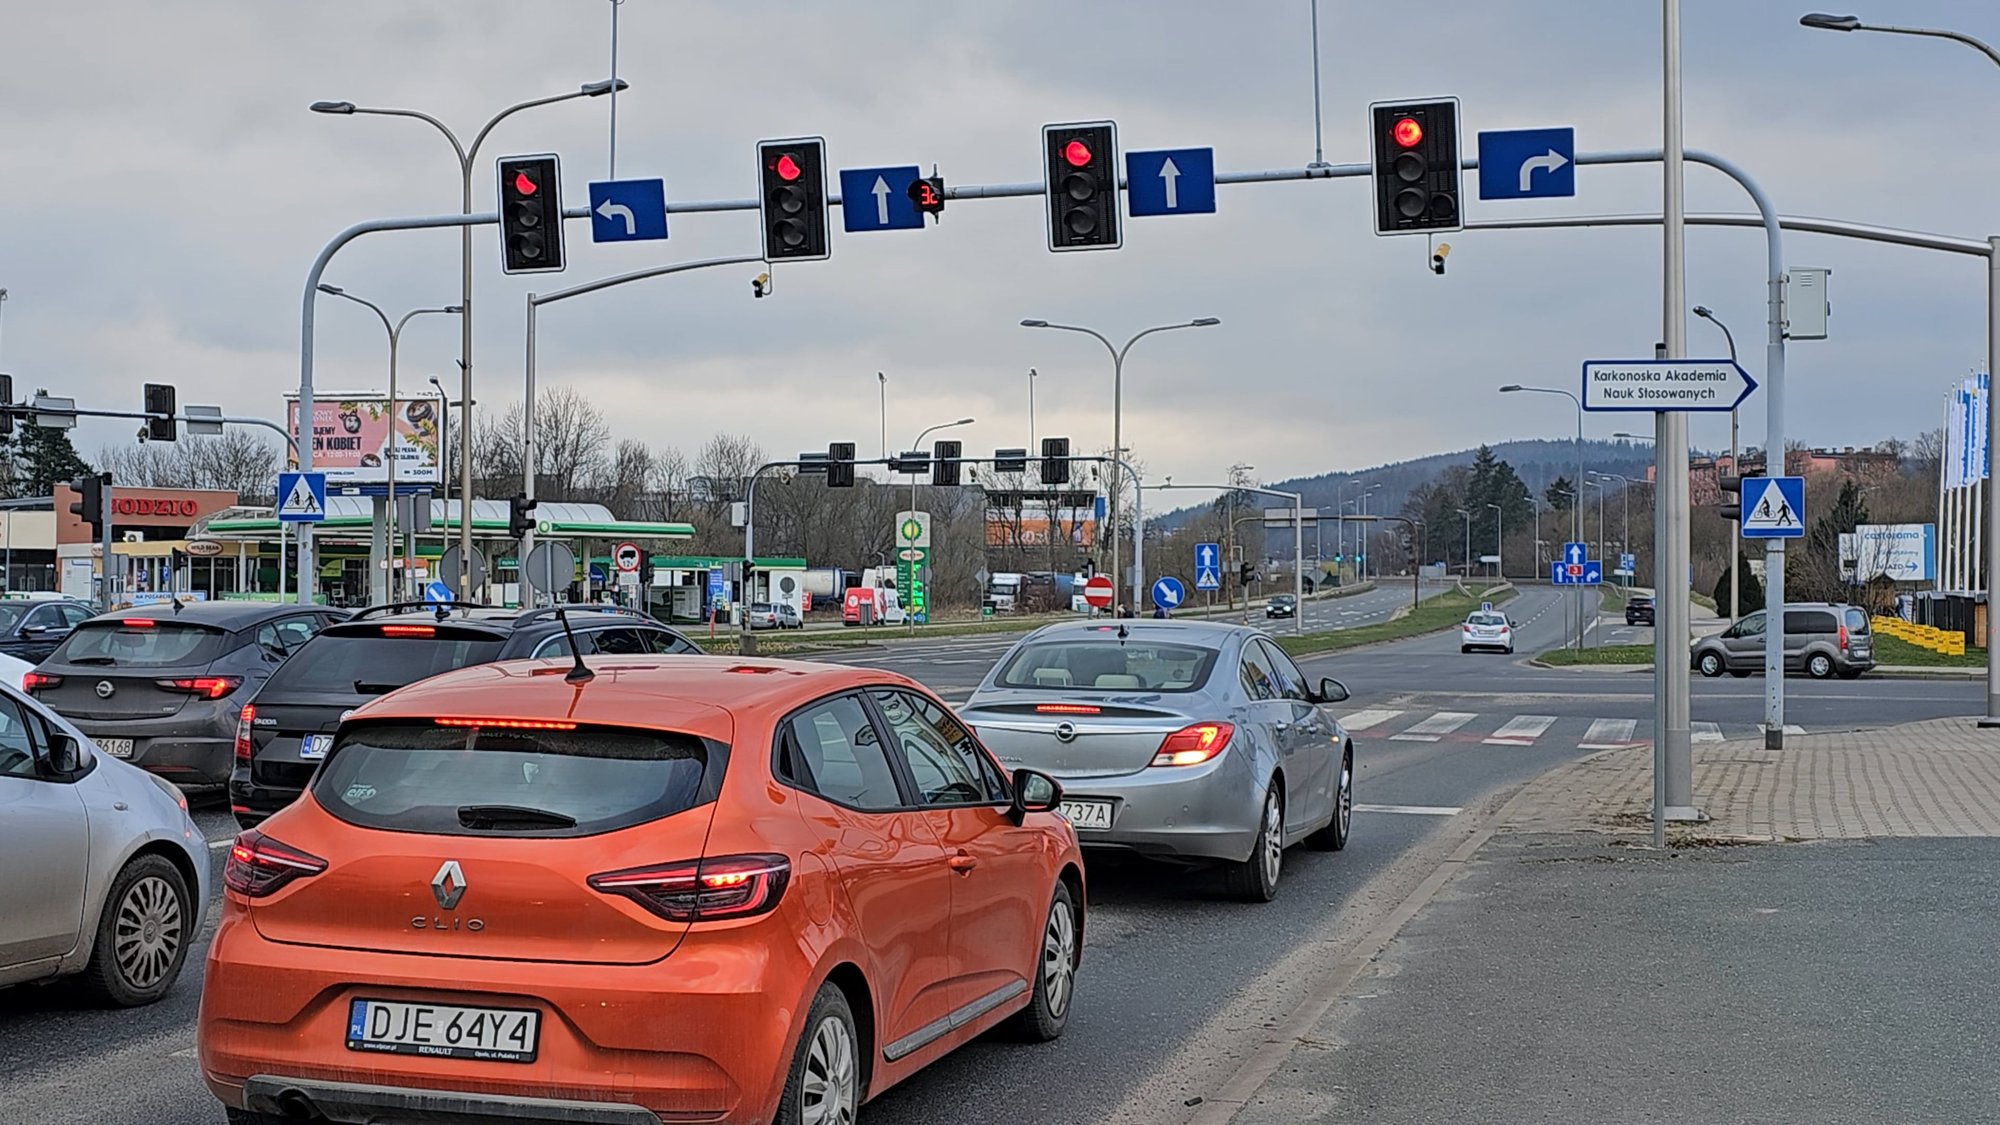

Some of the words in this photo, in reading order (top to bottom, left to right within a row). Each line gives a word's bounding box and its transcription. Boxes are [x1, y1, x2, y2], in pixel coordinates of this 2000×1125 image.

[1594, 369, 1661, 381] Karkonoska
[1665, 369, 1727, 381] Akademia
[1604, 387, 1634, 399] Nauk
[1637, 387, 1716, 401] Stosowanych
[326, 437, 362, 450] KOBIET
[412, 916, 485, 931] CLIO
[352, 1024, 363, 1035] PL
[371, 1005, 434, 1043] DJE
[446, 1011, 528, 1050] 64Y4
[418, 1046, 453, 1055] RENAULT
